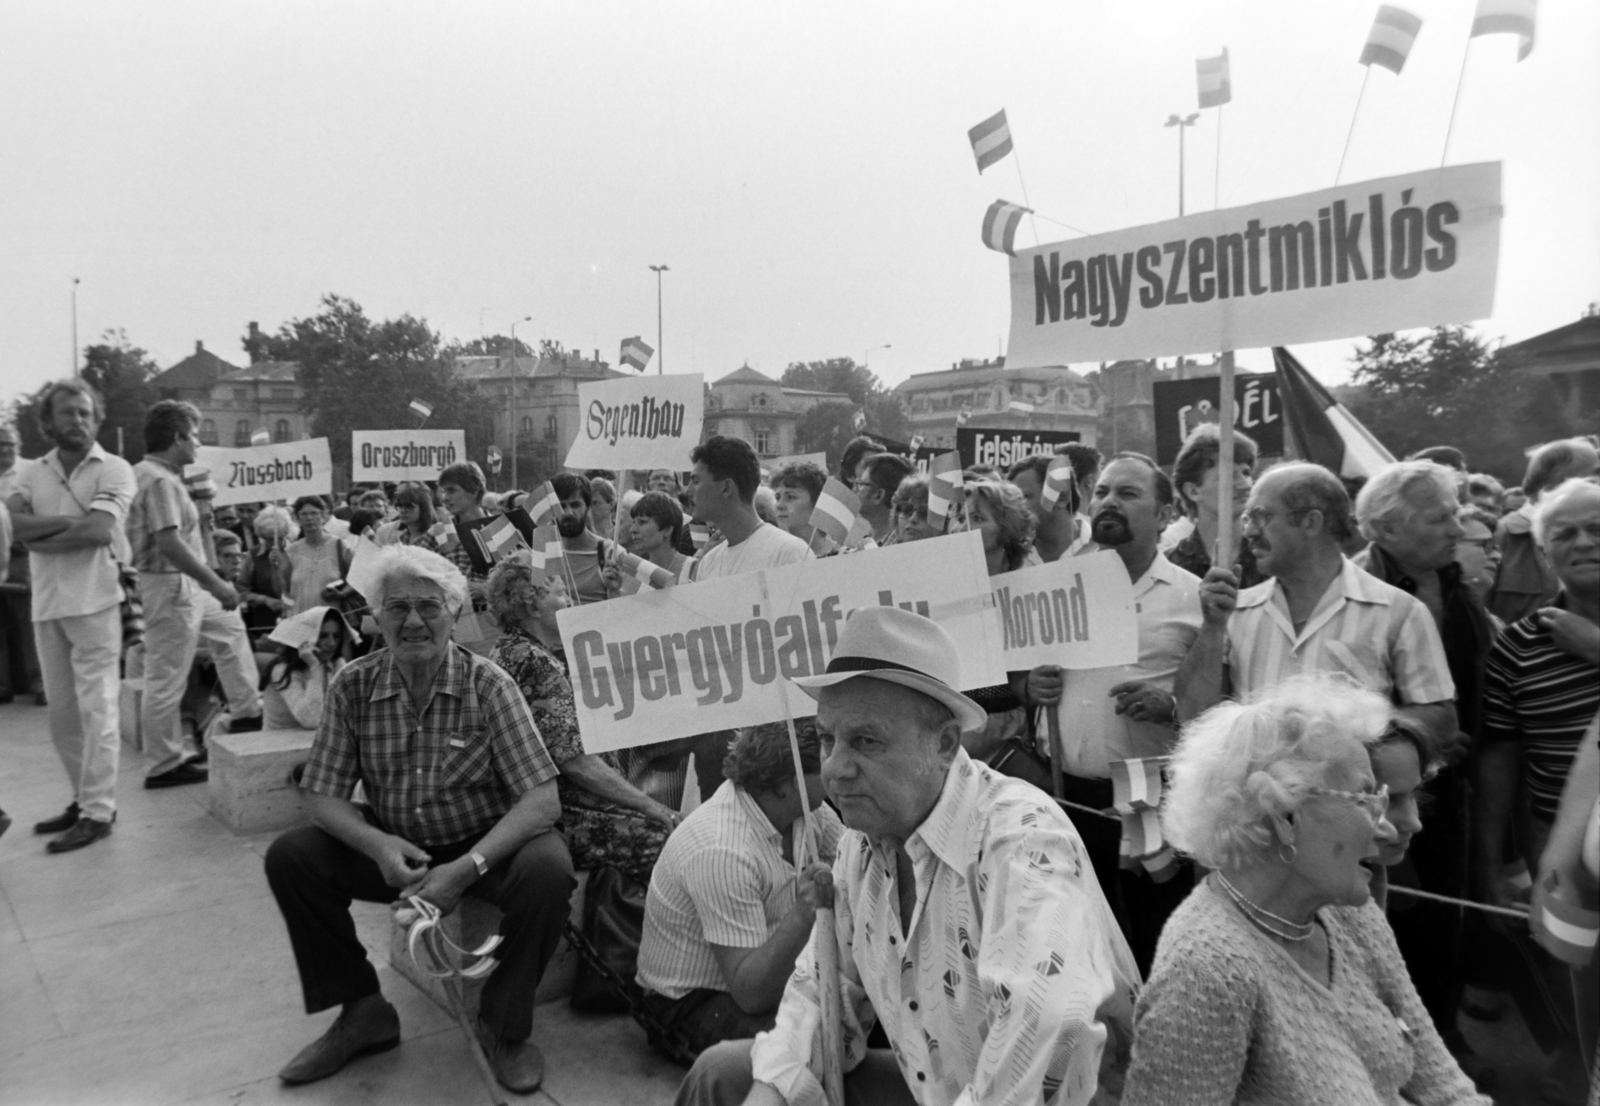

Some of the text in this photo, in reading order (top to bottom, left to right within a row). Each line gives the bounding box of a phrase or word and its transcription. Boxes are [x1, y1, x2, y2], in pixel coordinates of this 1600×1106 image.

[1033, 188, 1460, 328] Nagyszentmiklós
[586, 395, 685, 447] Segenthau
[228, 455, 313, 488] Nussbach
[361, 440, 456, 471] Oroszborgó
[997, 572, 1090, 651] Korond
[572, 590, 934, 721] Gyergyóalf
